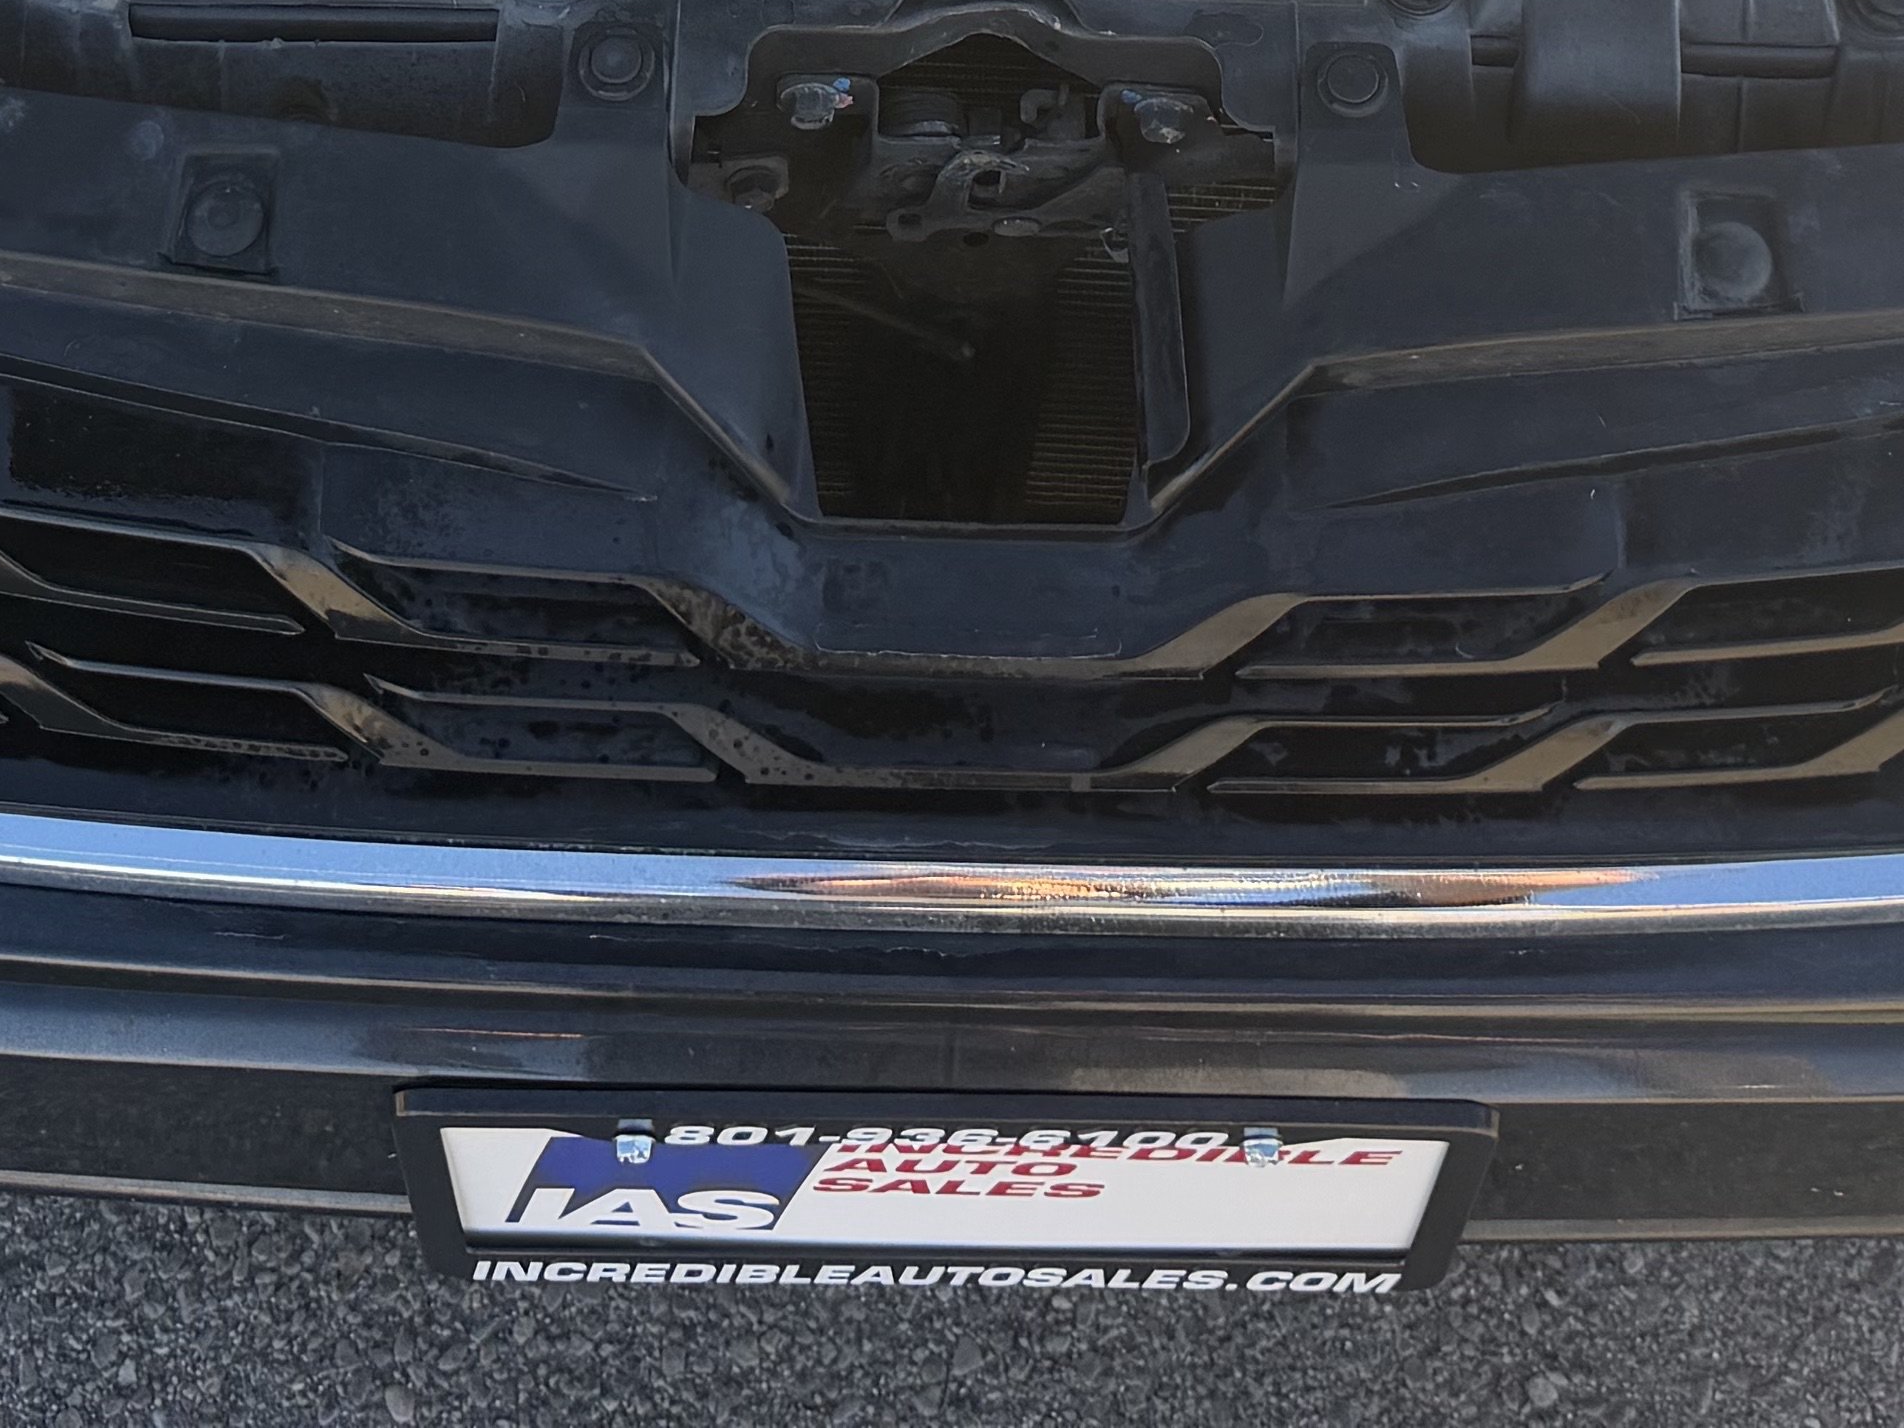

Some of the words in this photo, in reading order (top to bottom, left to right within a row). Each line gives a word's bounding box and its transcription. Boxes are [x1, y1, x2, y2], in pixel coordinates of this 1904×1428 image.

[664, 1126, 1229, 1148] 801-936-6100
[823, 1158, 1077, 1177] AUTO
[812, 1177, 1106, 1198] SALES
[512, 1187, 781, 1231] IAS
[471, 1258, 1402, 1295] INCREDIBLEAUTOSALES.COM
